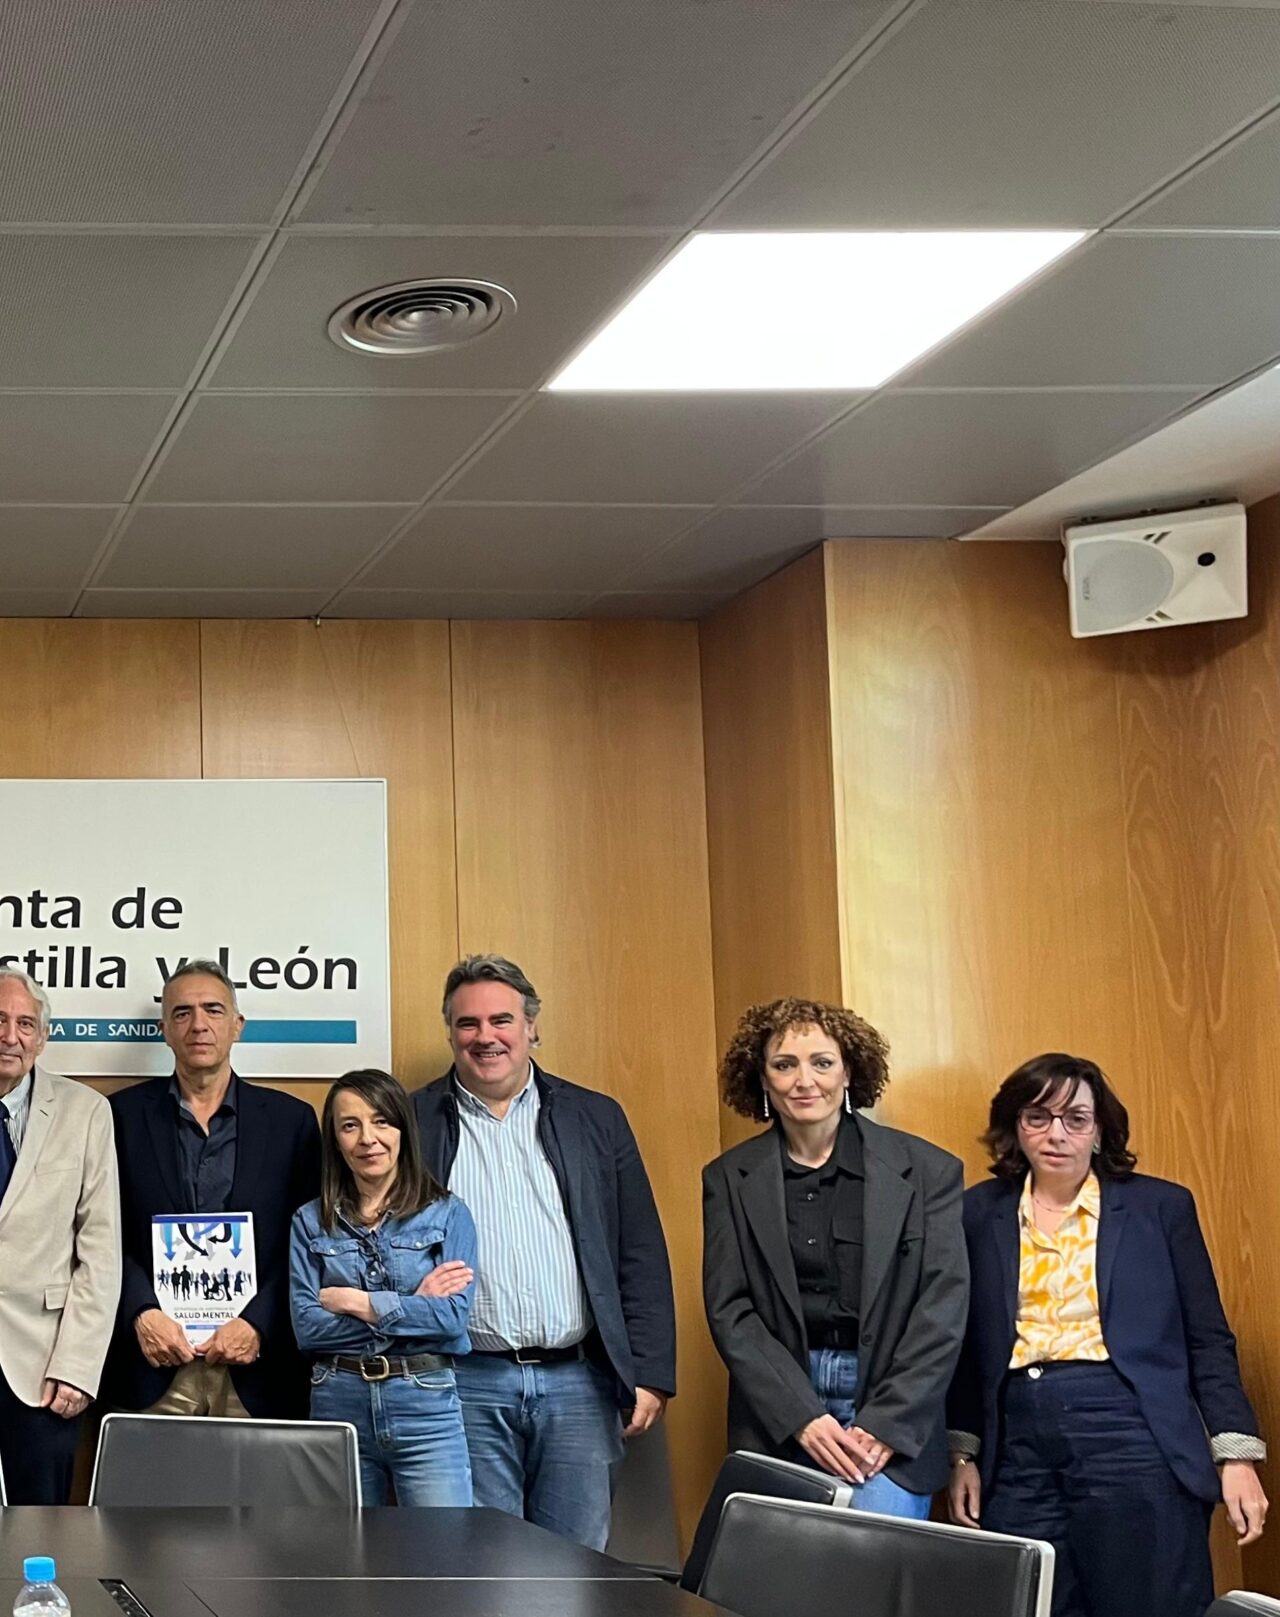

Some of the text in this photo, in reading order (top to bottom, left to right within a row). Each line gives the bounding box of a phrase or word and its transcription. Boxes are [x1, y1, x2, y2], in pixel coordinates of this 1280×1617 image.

[111, 887, 183, 930] de
[218, 945, 358, 990] León
[75, 1023, 98, 1036] DE
[107, 1023, 162, 1037] SANID
[174, 1311, 234, 1319] SALUD MENTAL
